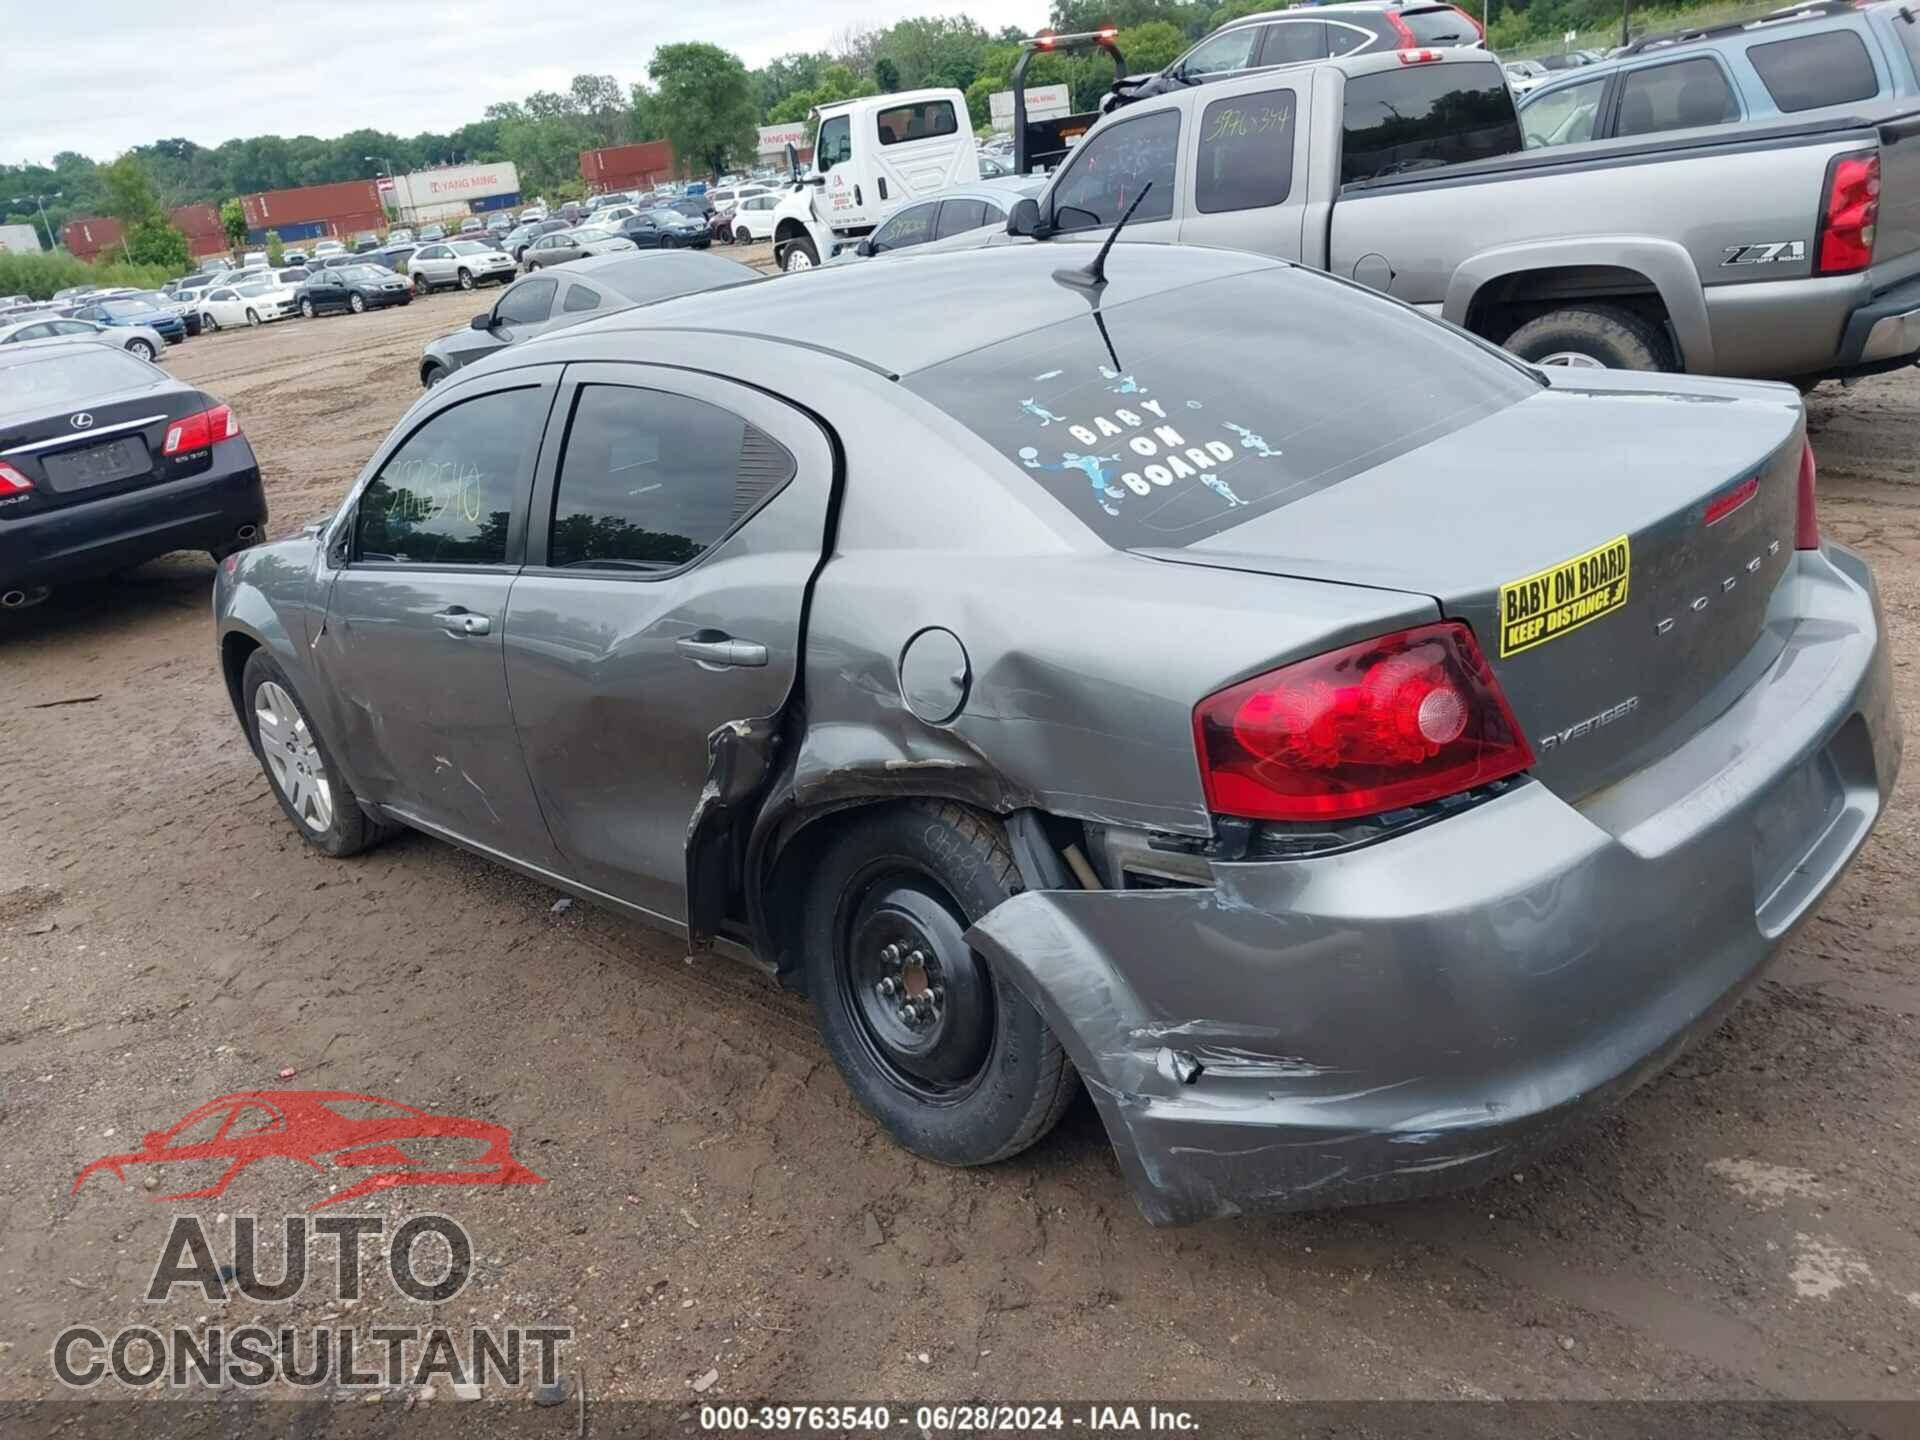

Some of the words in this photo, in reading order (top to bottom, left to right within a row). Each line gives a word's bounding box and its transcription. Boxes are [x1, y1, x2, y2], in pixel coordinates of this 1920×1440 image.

[442, 180, 470, 193] YANG
[471, 174, 497, 188] MING
[1720, 240, 1805, 266] Z71
[1068, 399, 1167, 445] BABY
[1129, 425, 1185, 456] ON
[1121, 441, 1234, 496] BOARD
[1506, 576, 1550, 623] BABY
[1555, 565, 1576, 604] ON
[1579, 543, 1626, 594] BOARD
[1655, 540, 1780, 637] DODGE
[1508, 617, 1545, 647] KEEP
[1547, 587, 1610, 632] DISTANCE
[1540, 696, 1640, 751] AVENGER
